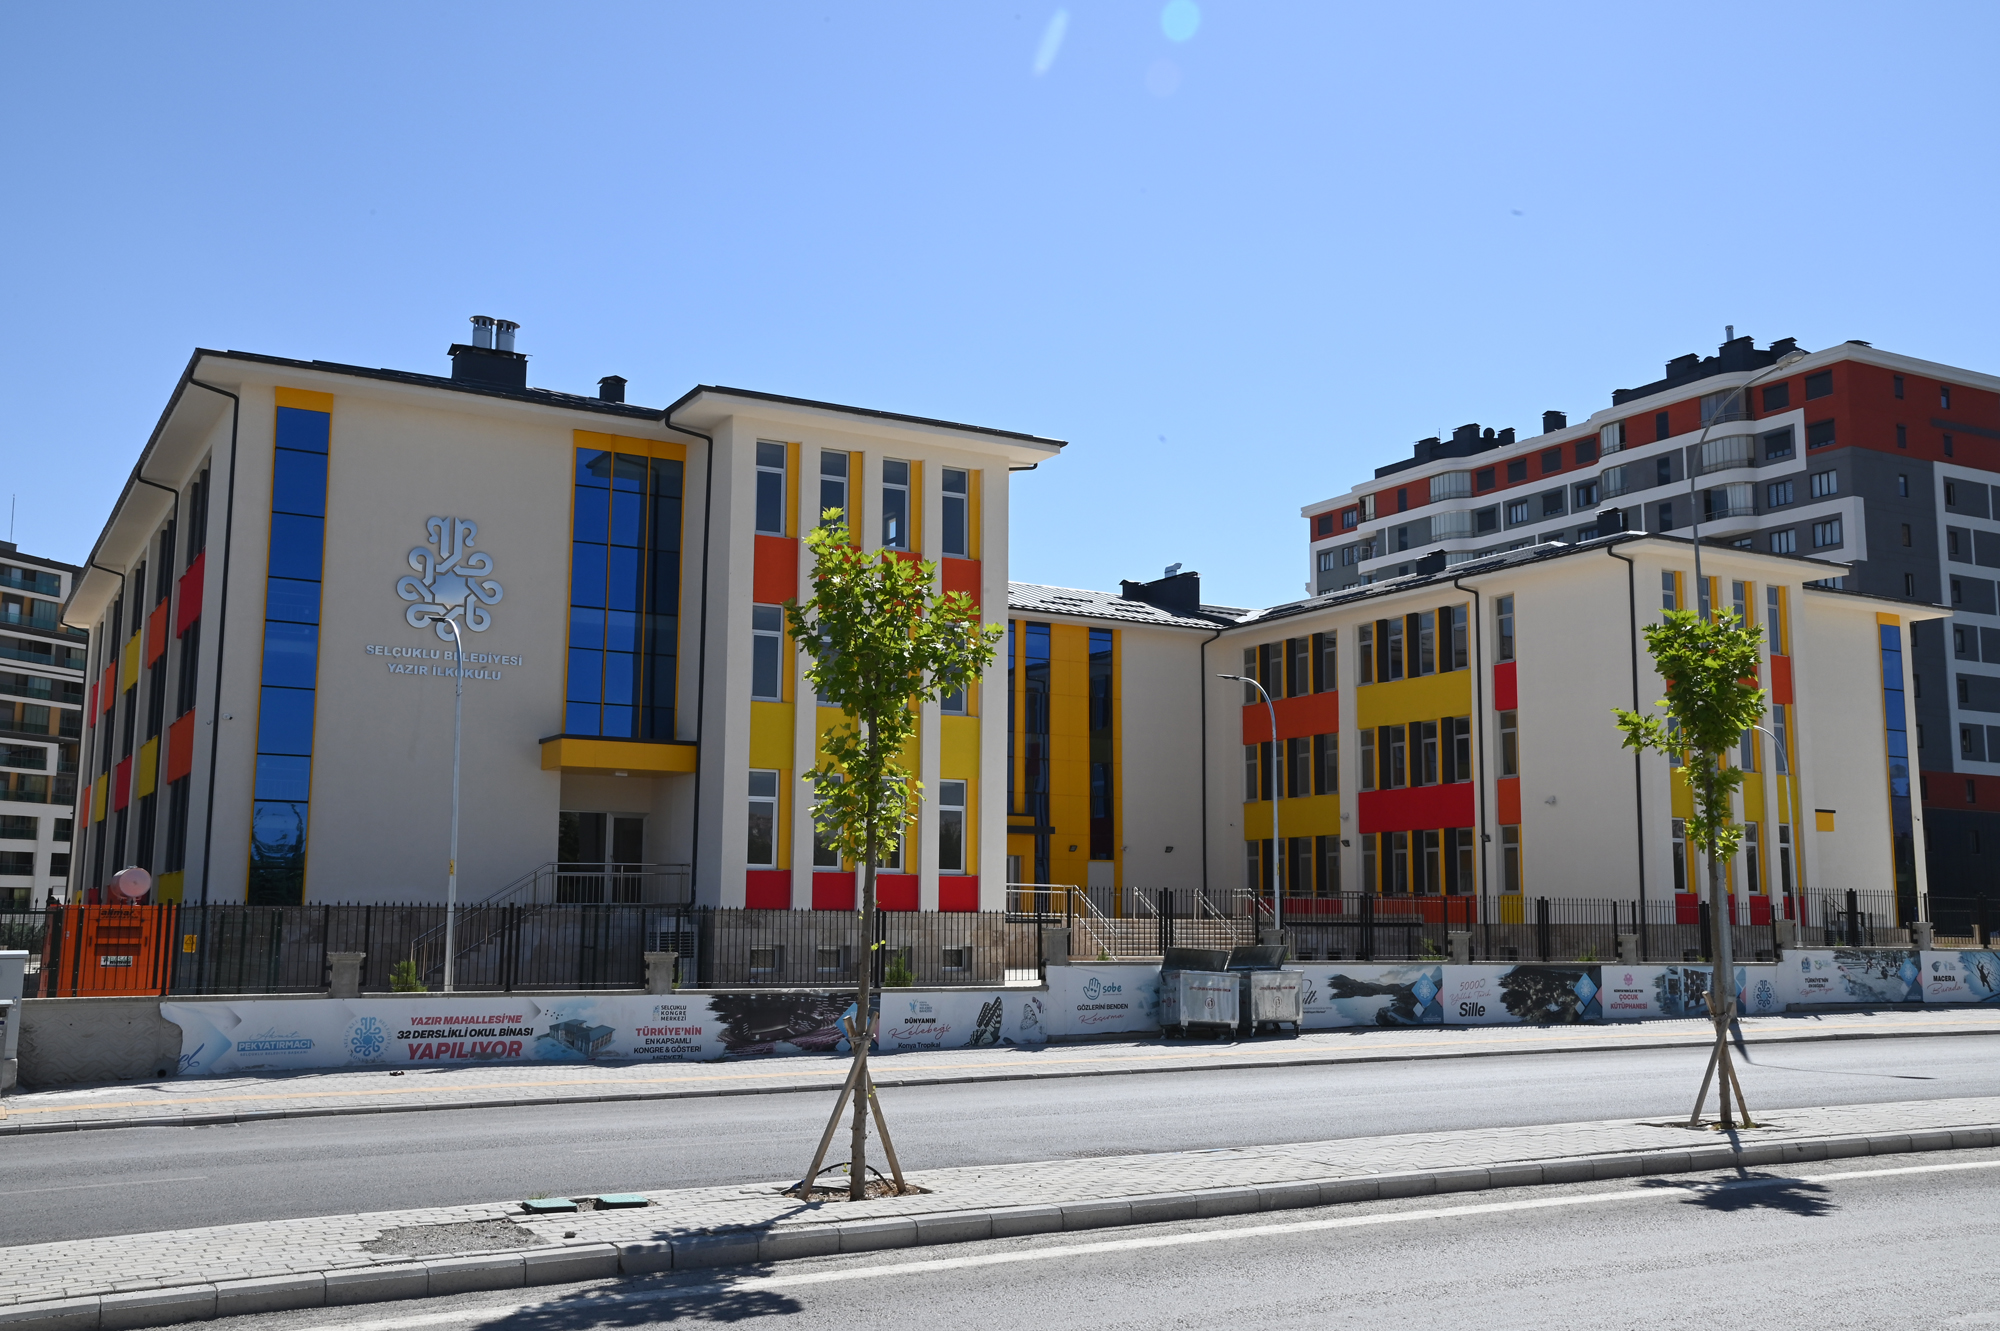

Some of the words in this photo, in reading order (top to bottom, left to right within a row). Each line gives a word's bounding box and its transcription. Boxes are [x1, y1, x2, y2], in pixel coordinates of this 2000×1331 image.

[365, 644, 440, 660] SELÇUKLU
[387, 662, 428, 676] YAZIR
[1102, 982, 1122, 993] sobe
[1459, 1002, 1486, 1017] Sille
[1610, 1002, 1648, 1010] KÜTÜPHANESİ
[411, 1016, 442, 1026] YAZIR
[443, 1013, 523, 1025] MAHALLESİ'NE
[397, 1030, 412, 1040] 32
[412, 1027, 469, 1039] DERSLİKLİ
[470, 1028, 497, 1038] OKUL
[498, 1026, 534, 1037] BİNASI
[635, 1025, 702, 1037] TÜRKİYE'NİN
[239, 1040, 311, 1051] PEKYATIRMACI
[408, 1040, 523, 1060] YAPILIYOR
[671, 1045, 702, 1053] GÖSTERİ
